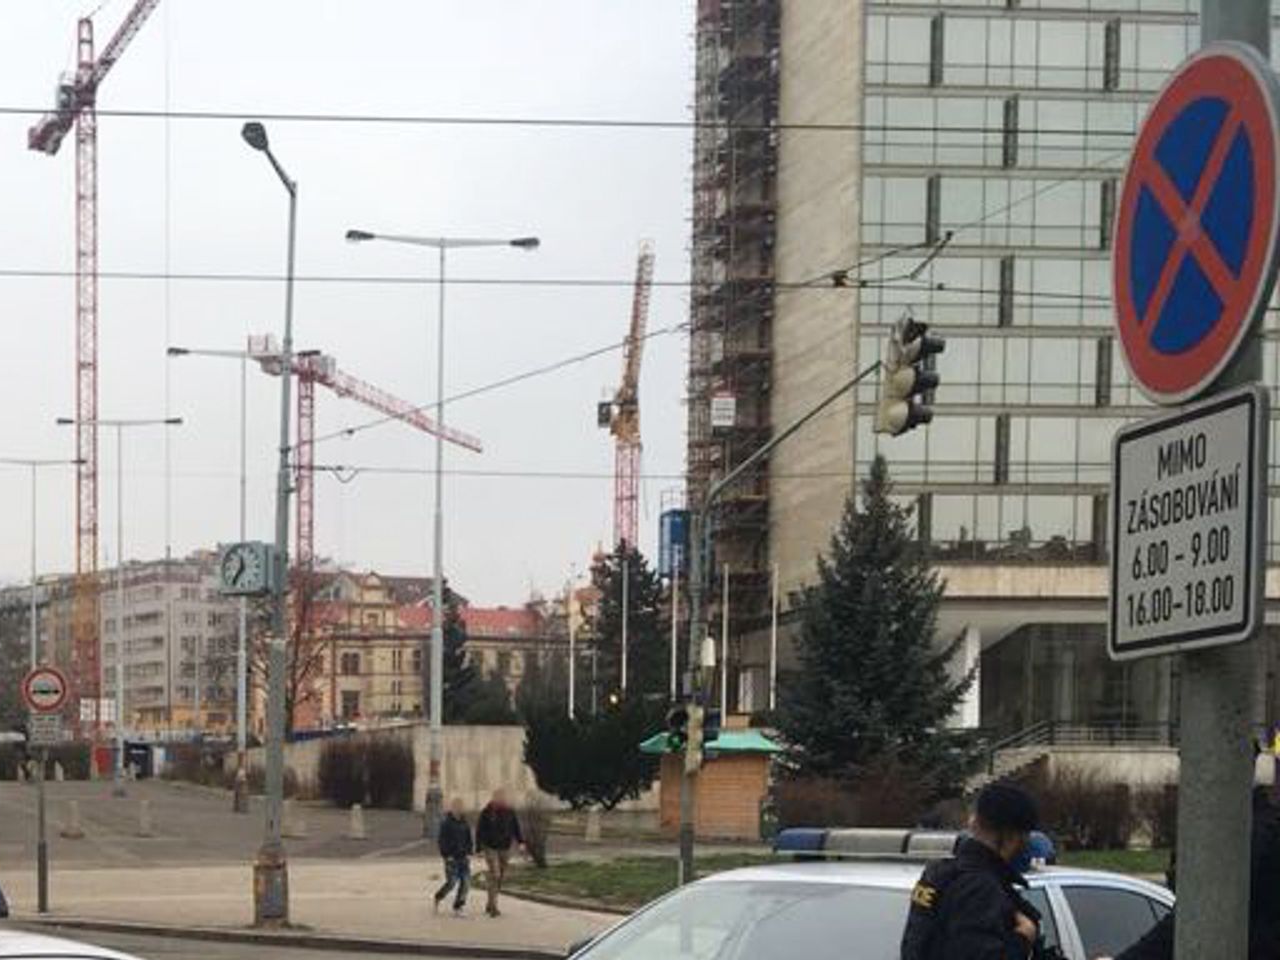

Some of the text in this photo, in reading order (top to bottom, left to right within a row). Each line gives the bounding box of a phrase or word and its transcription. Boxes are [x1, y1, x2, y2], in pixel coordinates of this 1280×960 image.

[1157, 433, 1206, 480] MIMO
[1127, 463, 1241, 534] ZÁSOBOVÁNÍ
[1132, 540, 1169, 581] 6.00
[1191, 525, 1230, 567] 9.00
